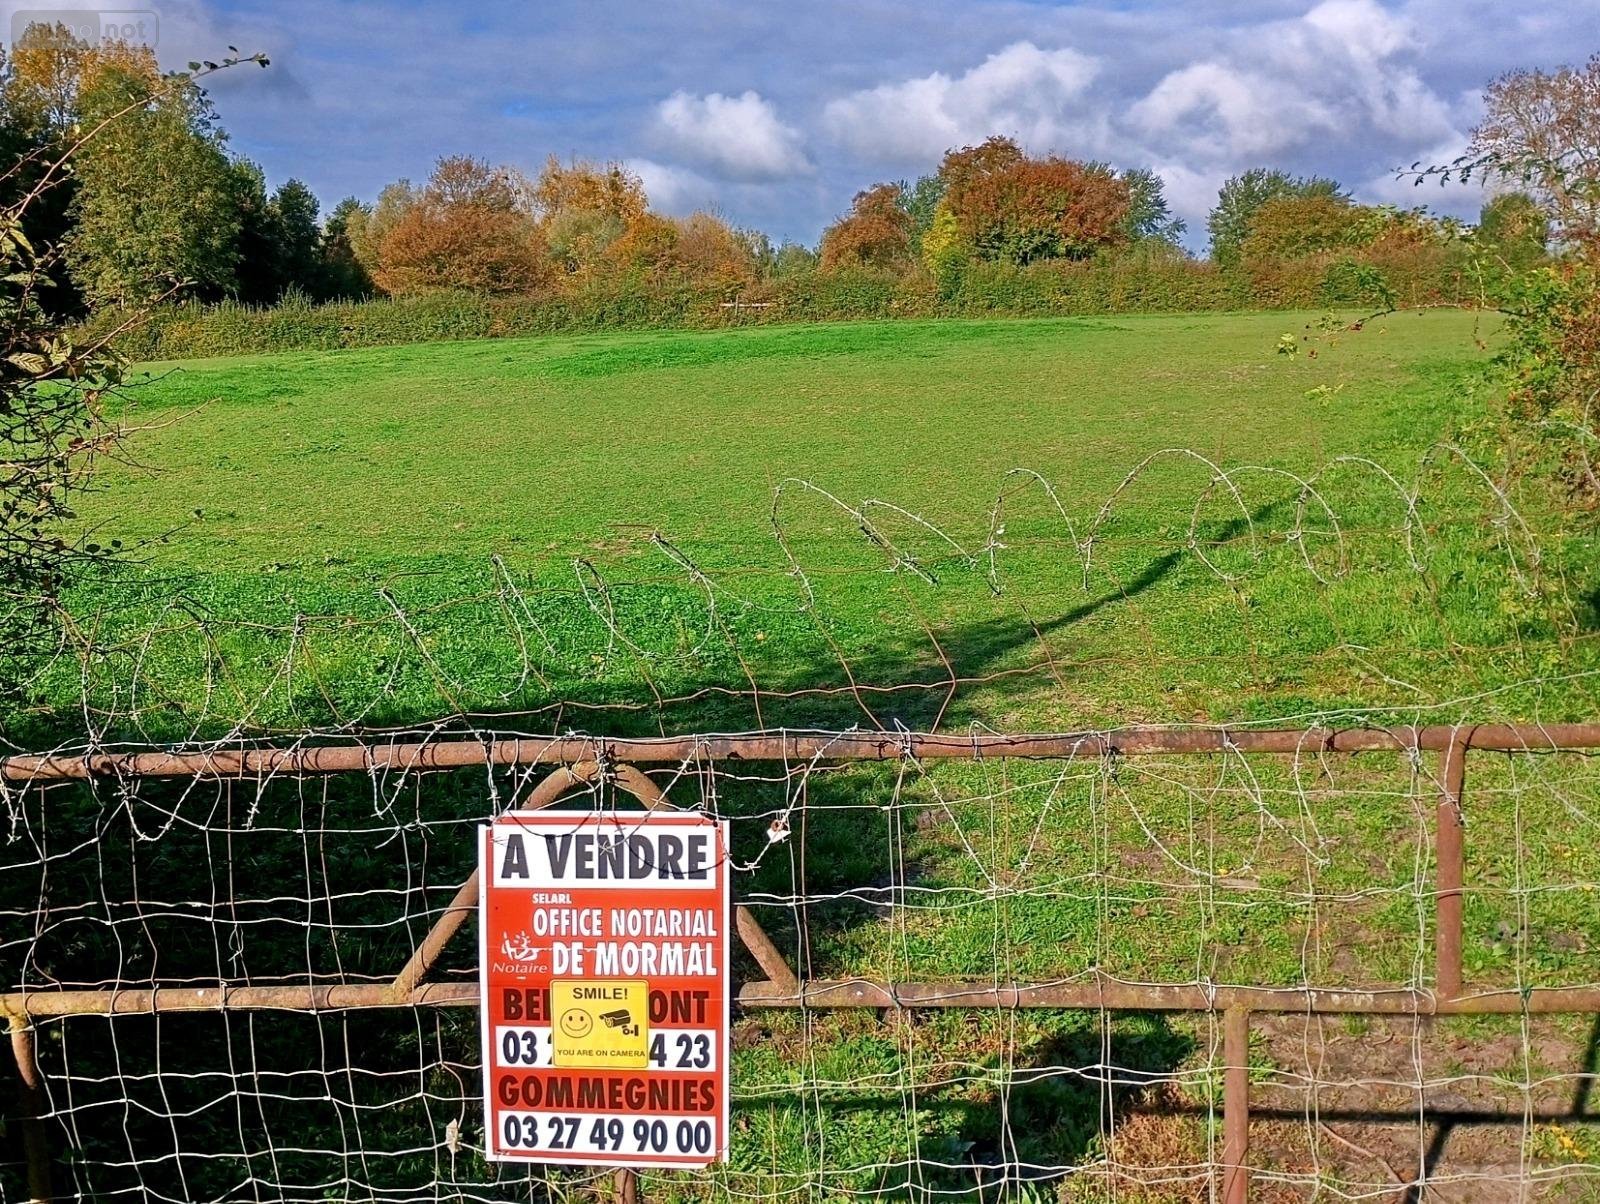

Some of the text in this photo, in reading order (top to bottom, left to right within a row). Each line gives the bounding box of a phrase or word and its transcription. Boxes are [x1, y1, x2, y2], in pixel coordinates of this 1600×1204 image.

[501, 833, 708, 880] A VENDRE
[532, 893, 572, 904] SELARL
[533, 908, 717, 937] OFFICE NOTARIAL
[492, 962, 548, 973] Notaire
[552, 941, 717, 976] DE MORMAL
[572, 987, 628, 1000] SMILE!
[502, 1030, 538, 1065] 03
[676, 1034, 711, 1069] 23
[498, 1074, 715, 1112] GOMMEGNIES
[504, 1115, 711, 1154] 03 27 49 90 00
